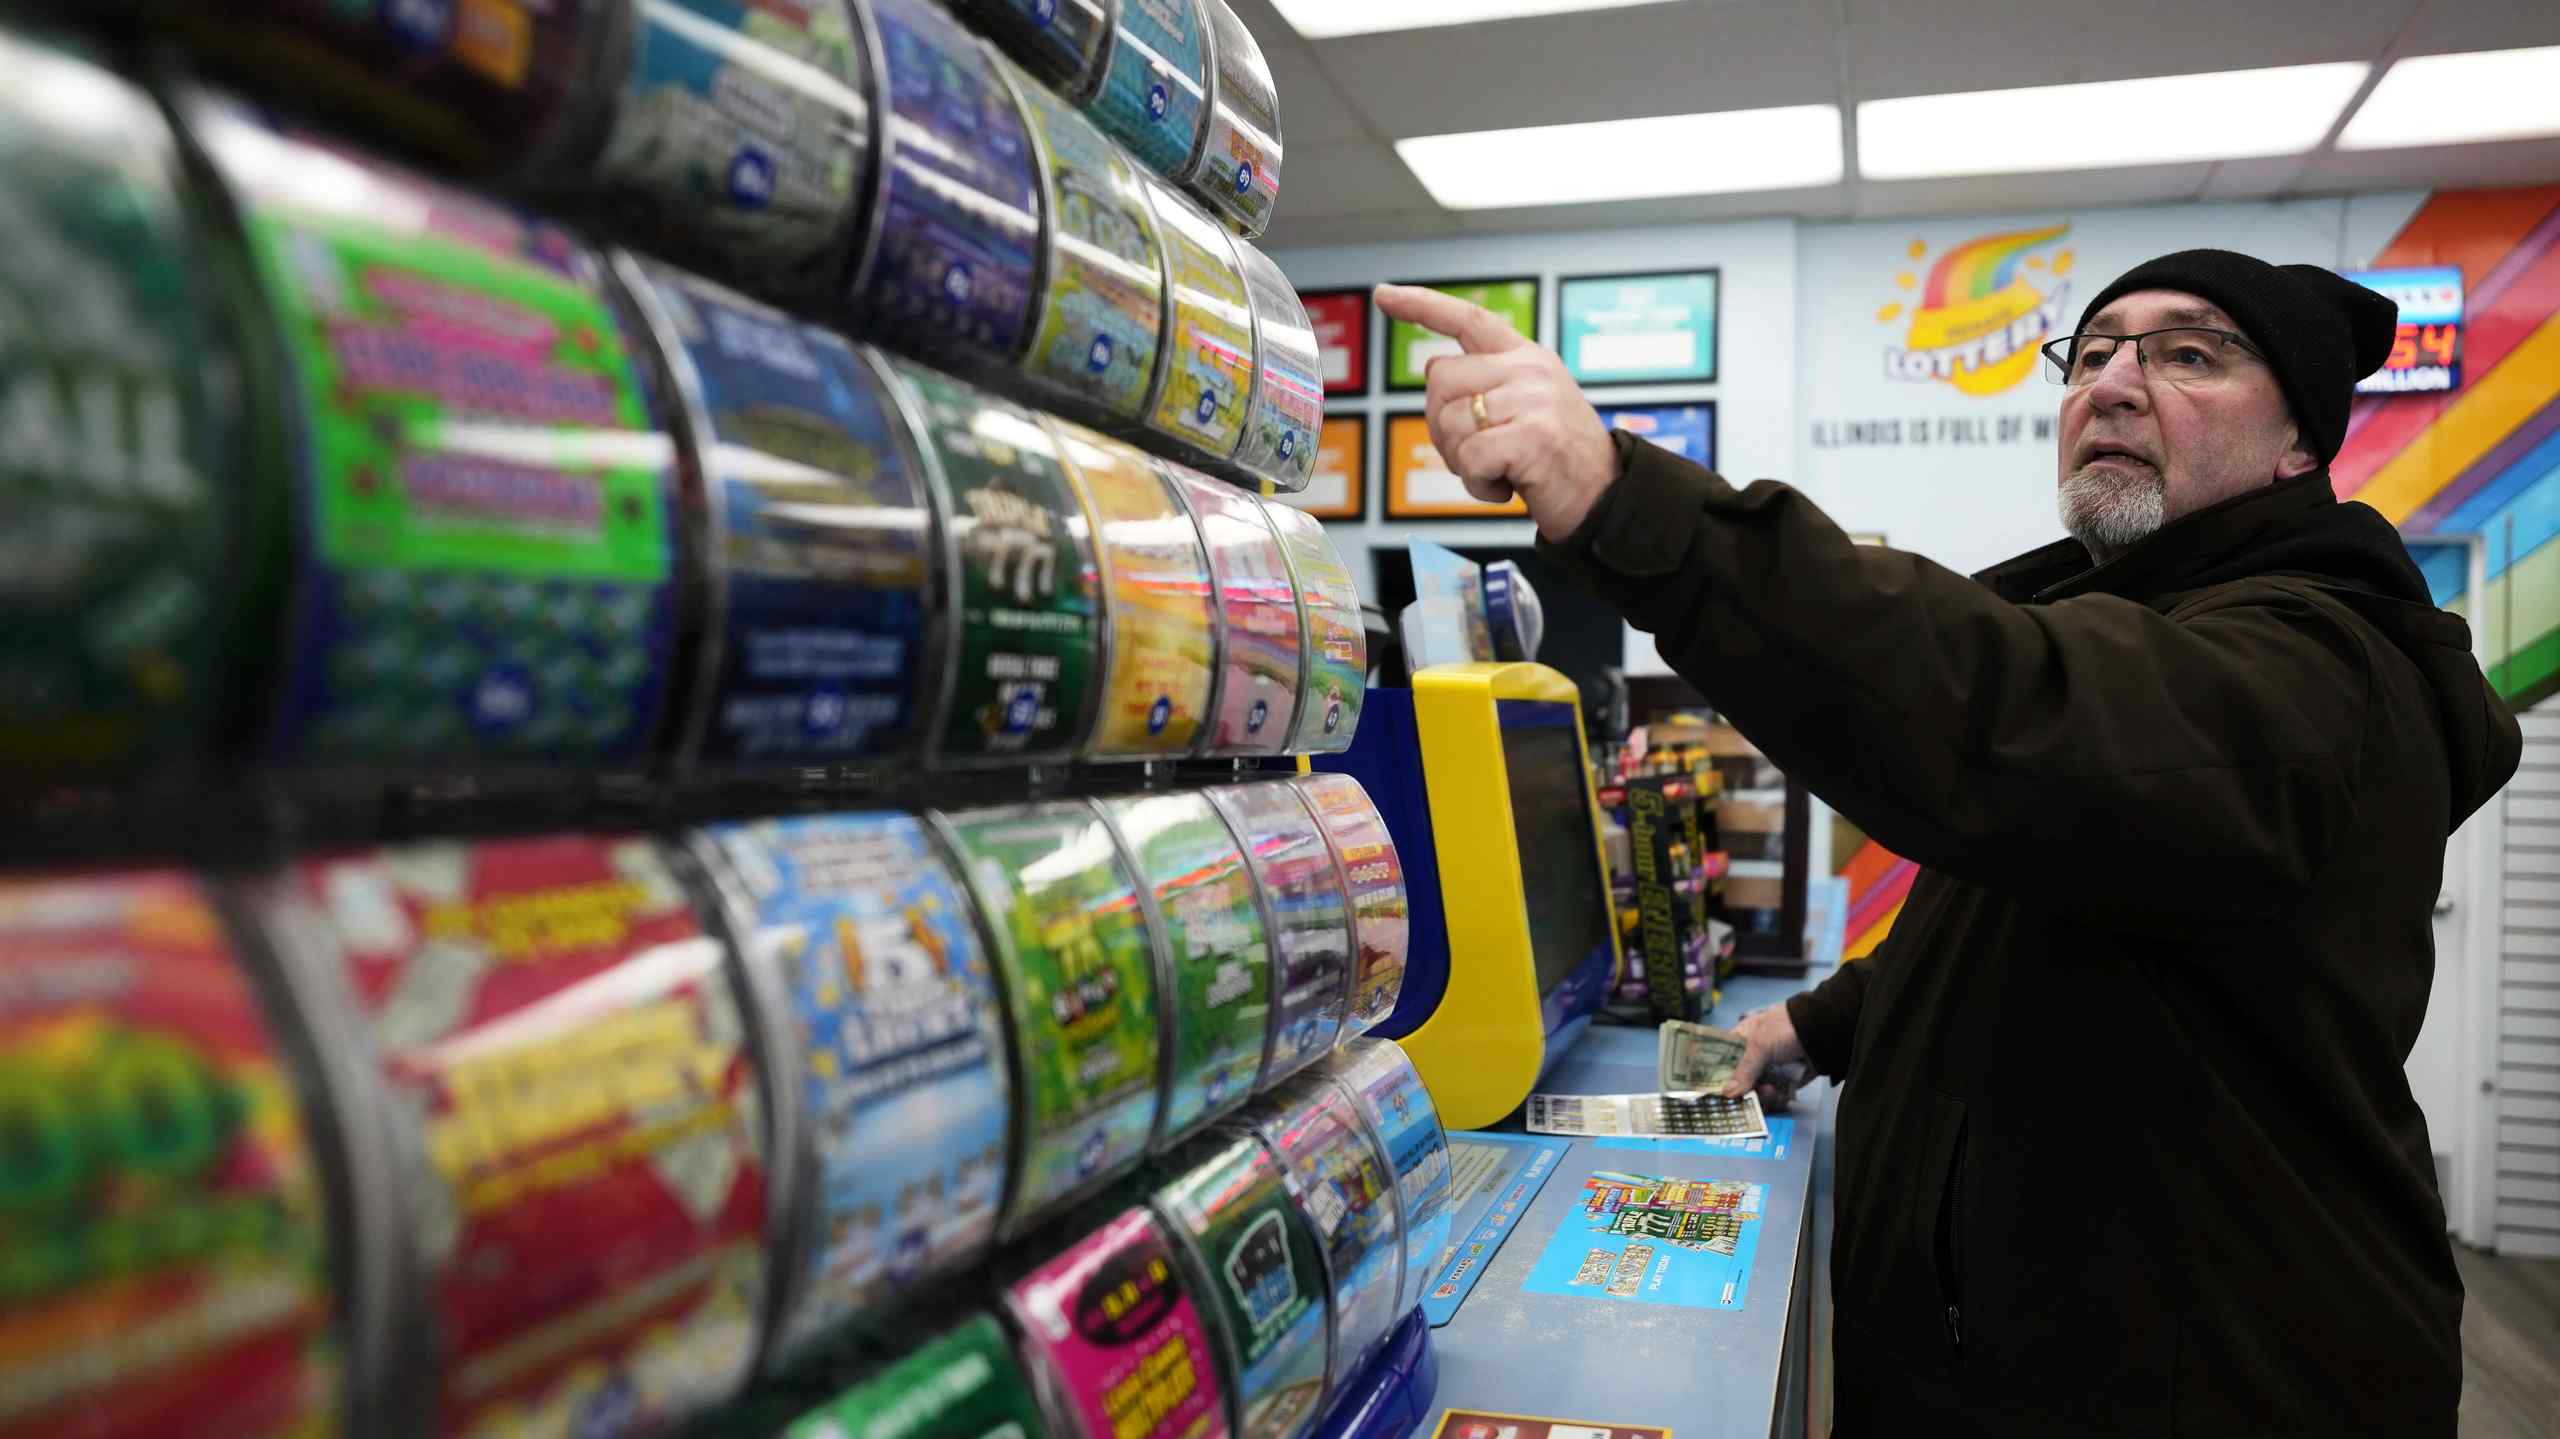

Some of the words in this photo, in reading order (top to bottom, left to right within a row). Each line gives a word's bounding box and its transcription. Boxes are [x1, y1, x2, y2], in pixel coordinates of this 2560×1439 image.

[1885, 282, 2071, 382] LOTTERY
[2385, 322, 2456, 369] 54
[1811, 418, 1902, 446] ILLINOIS
[1909, 417, 1929, 445] IS
[1938, 415, 1988, 445] FULL
[1997, 414, 2021, 445] OF
